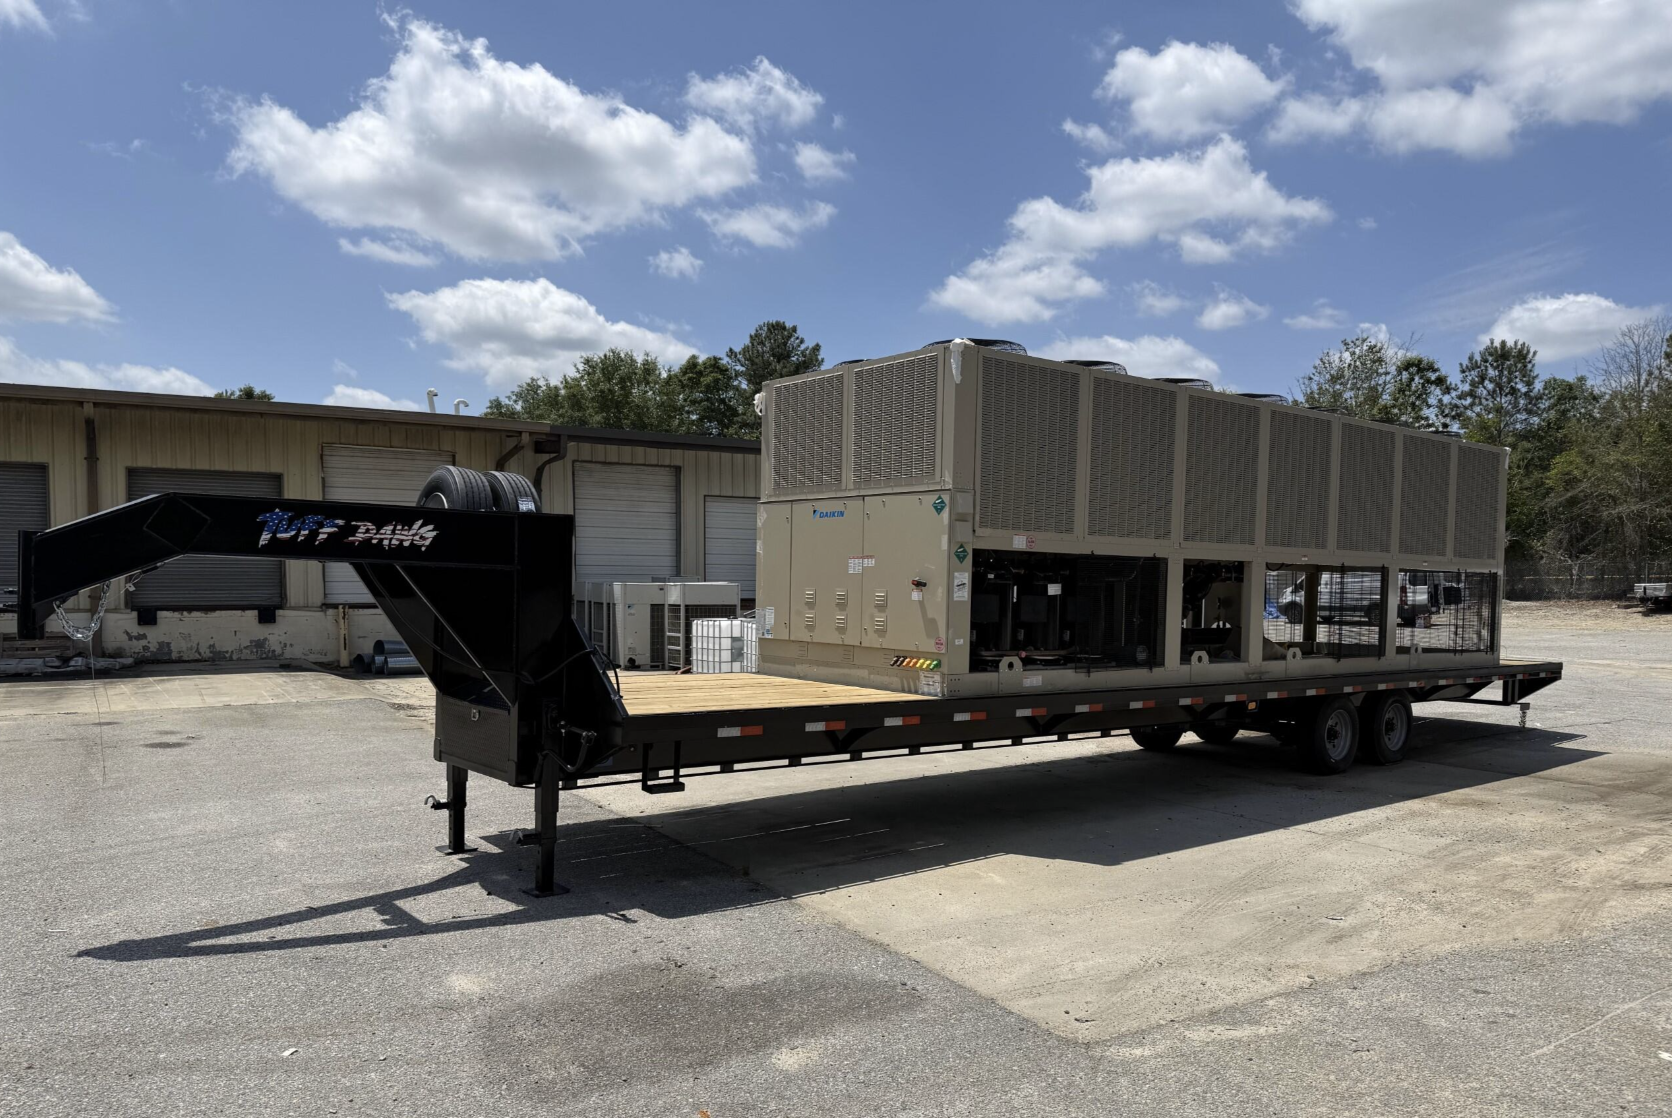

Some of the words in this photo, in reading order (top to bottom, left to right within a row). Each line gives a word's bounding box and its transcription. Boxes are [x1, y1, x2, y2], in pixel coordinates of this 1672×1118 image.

[819, 510, 845, 518] DAIKIN
[257, 508, 345, 548] TUFF
[344, 519, 439, 551] DAWG
